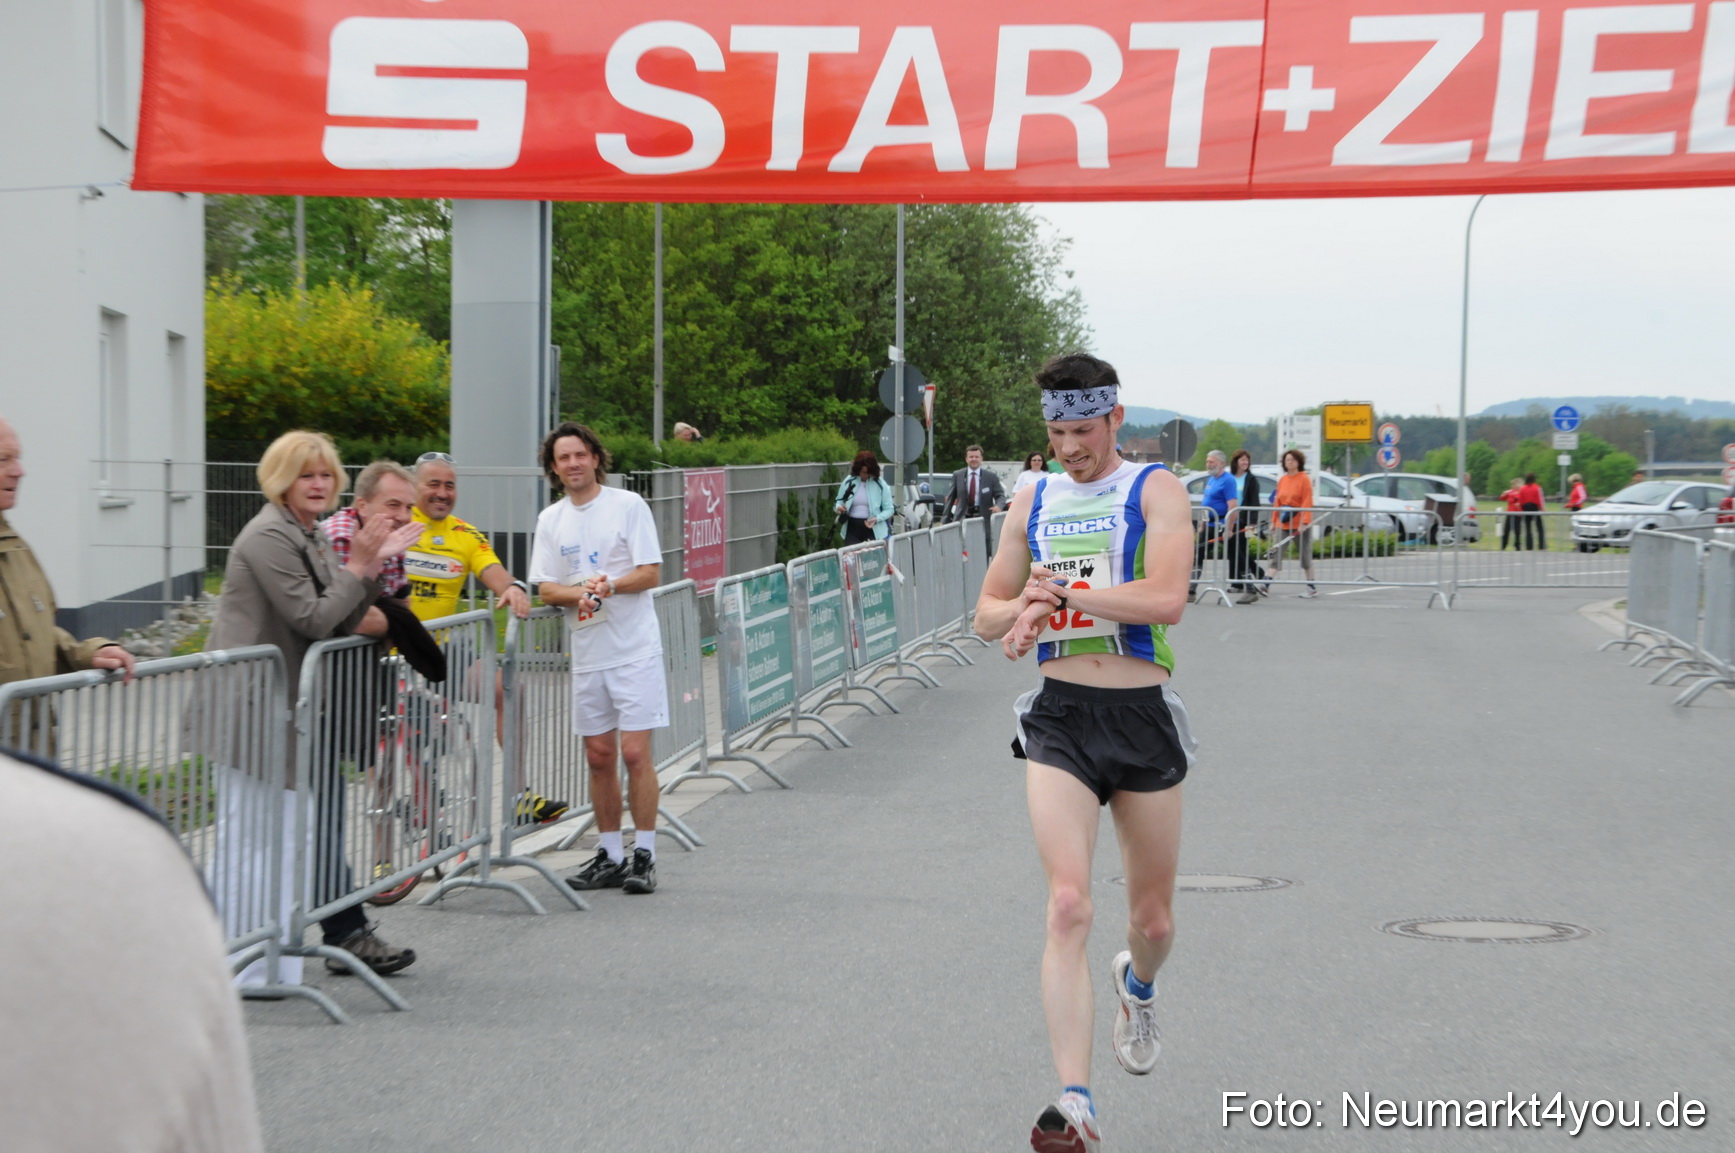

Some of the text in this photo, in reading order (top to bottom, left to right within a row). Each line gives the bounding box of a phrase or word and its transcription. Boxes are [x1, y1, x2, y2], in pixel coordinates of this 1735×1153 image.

[1328, 418, 1368, 427] Neumarkt
[691, 517, 721, 549] ZEITLOS
[1044, 515, 1117, 537] BOCK
